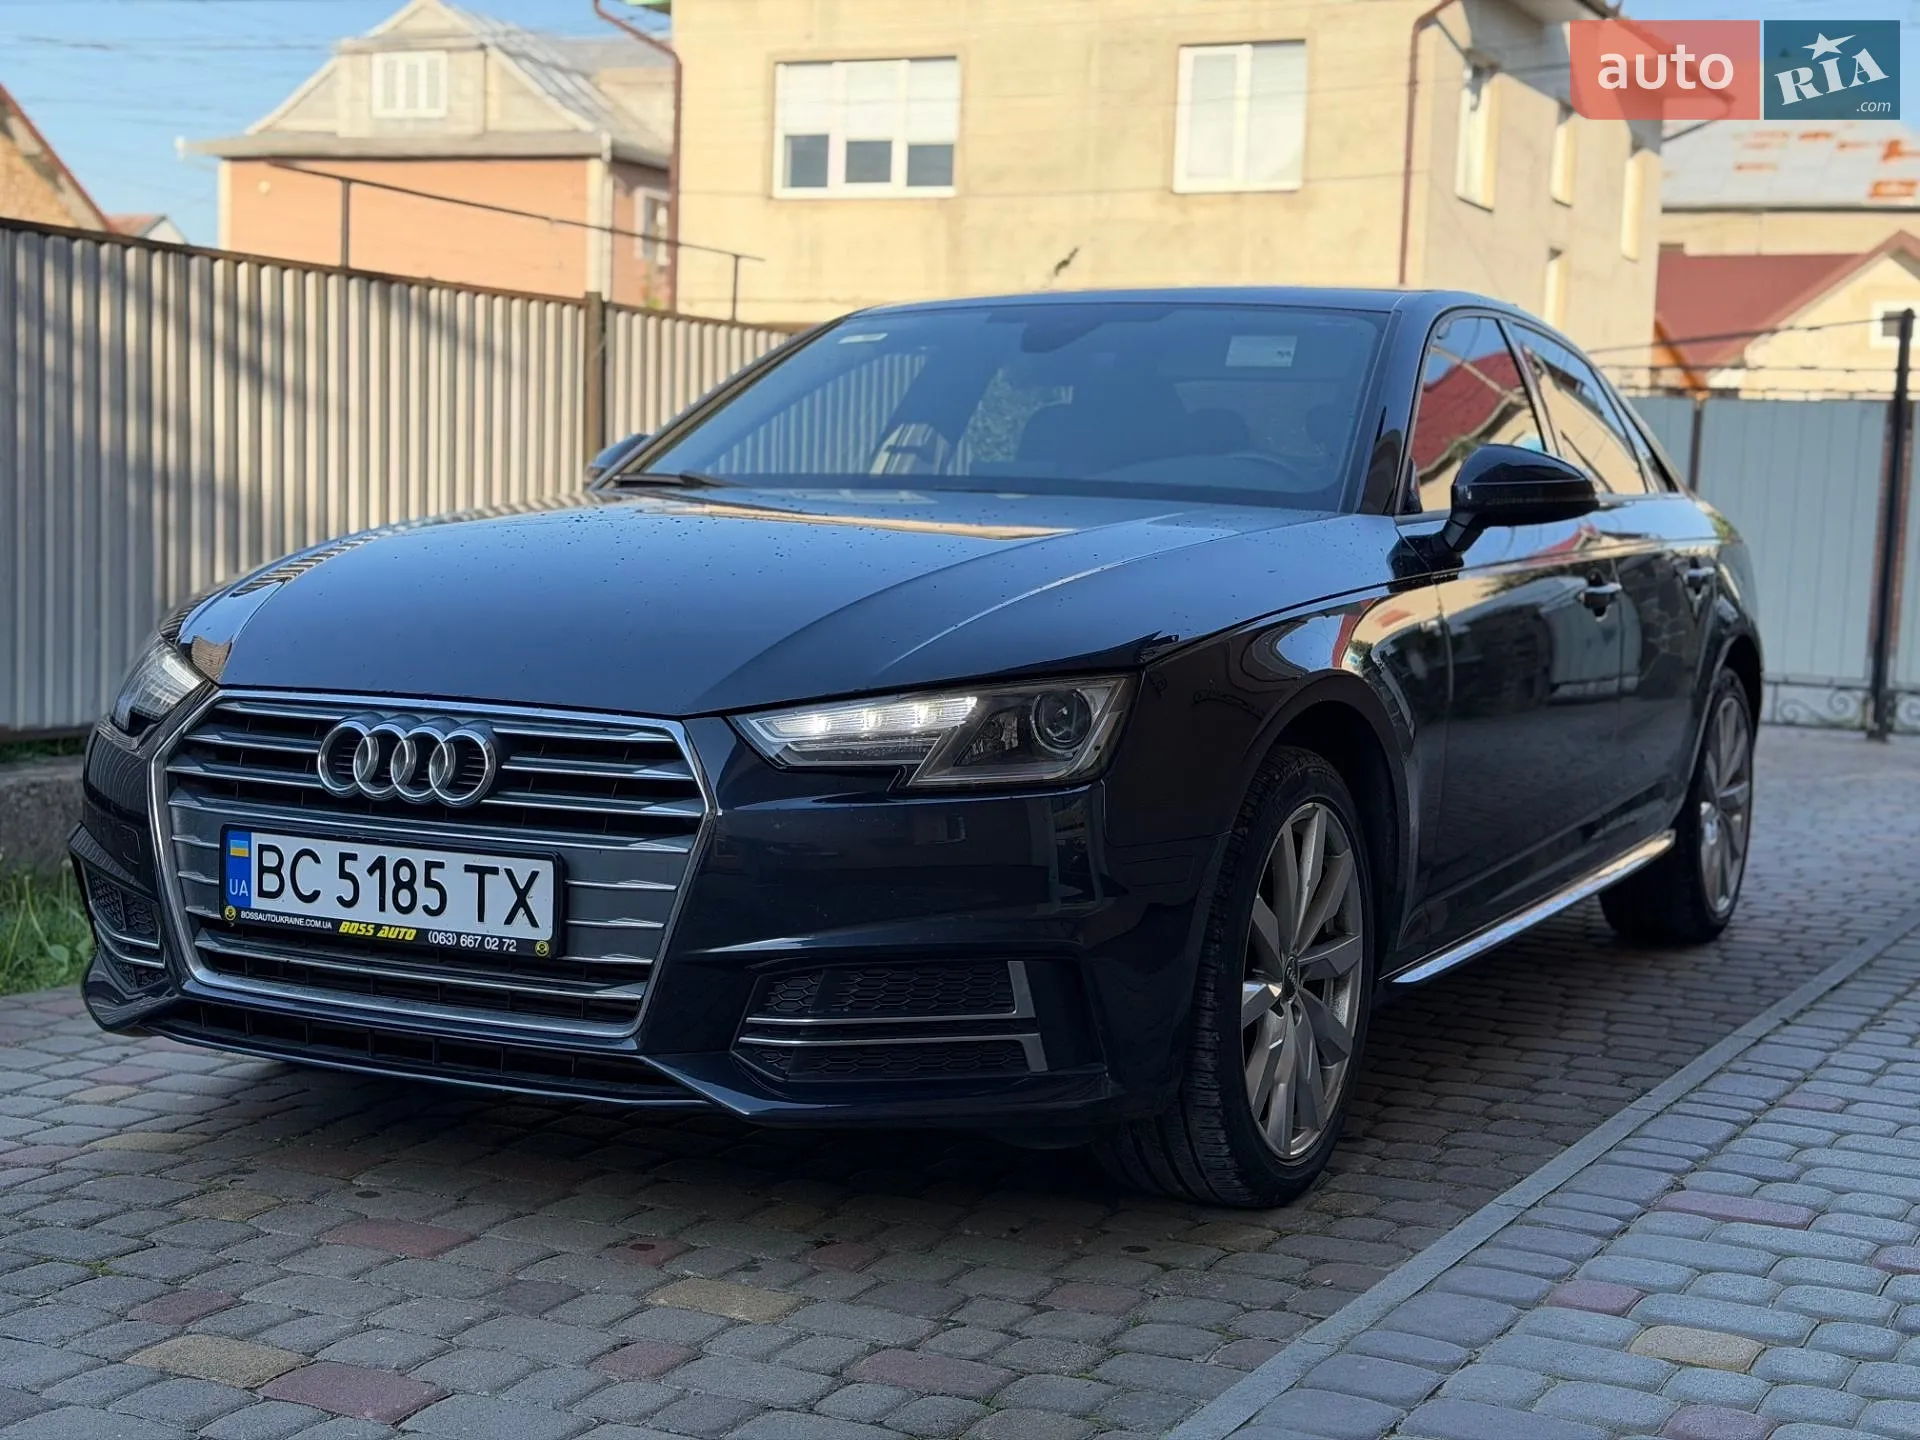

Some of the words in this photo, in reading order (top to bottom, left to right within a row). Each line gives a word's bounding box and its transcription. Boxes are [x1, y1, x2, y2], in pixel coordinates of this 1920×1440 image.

[229, 878, 249, 897] UA
[257, 843, 321, 903] BC
[336, 851, 447, 917] 5185
[464, 863, 540, 928] TX
[240, 910, 333, 929] BOSSAUTOUKRAINE.COM.UA
[338, 920, 375, 936] BOSS
[376, 925, 417, 941] AUTO
[427, 930, 457, 946] (063)
[460, 933, 482, 948] 667
[484, 936, 500, 950] 02
[502, 938, 517, 952] 72
